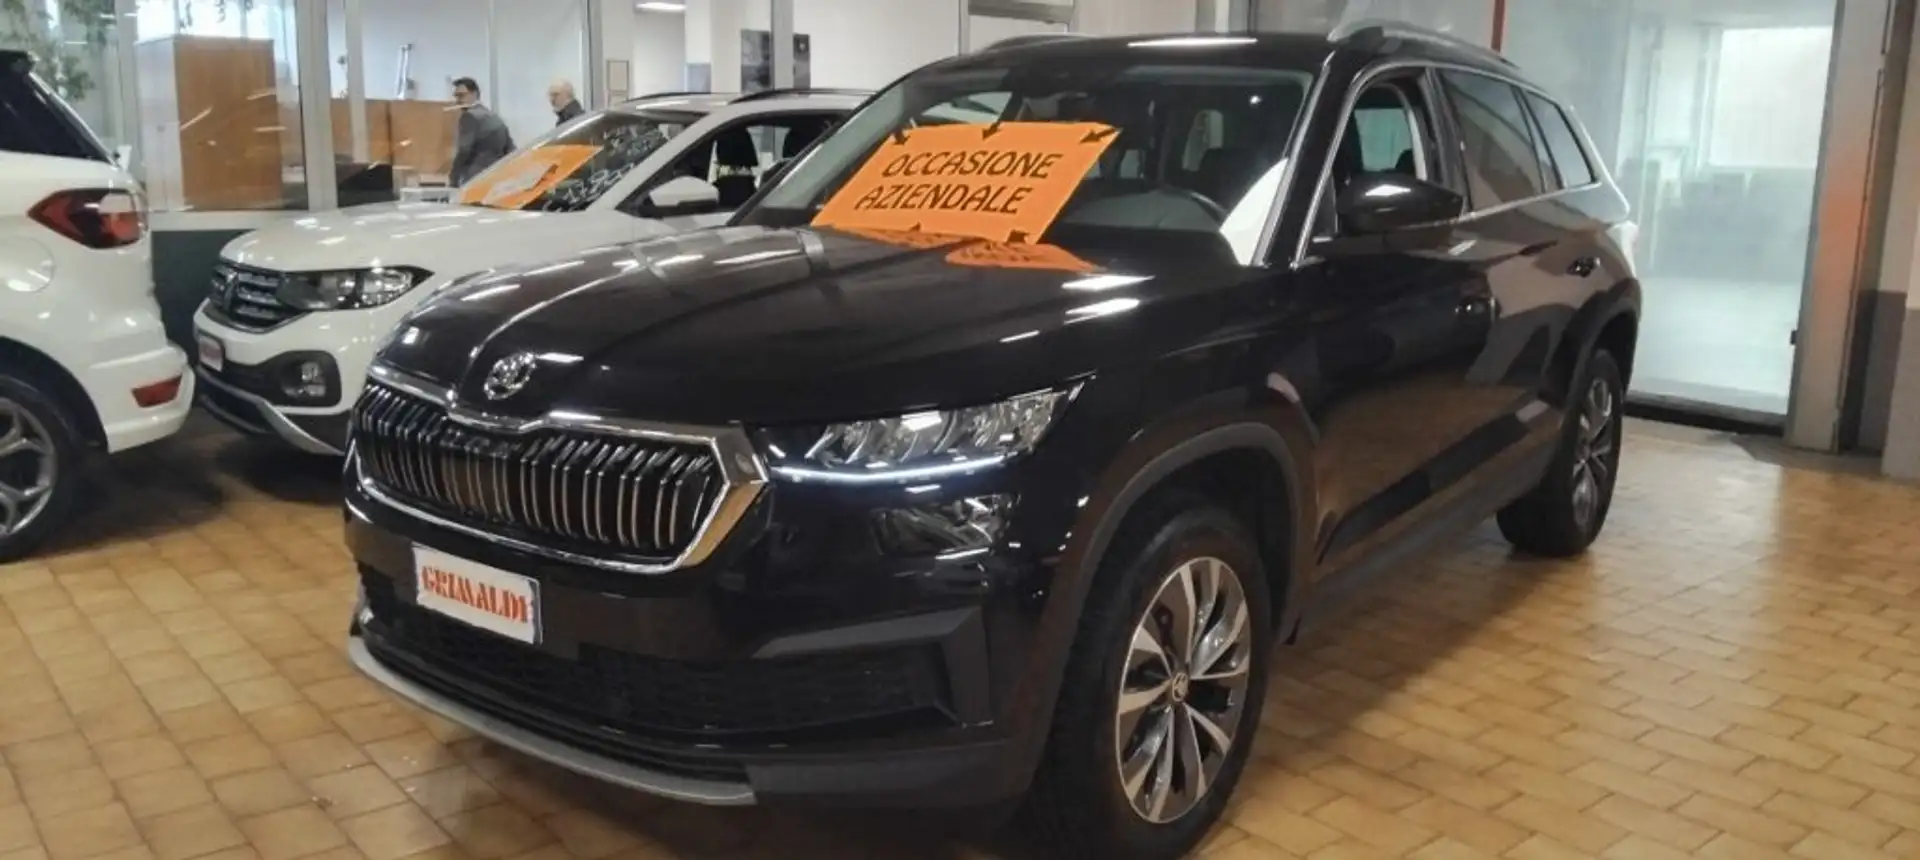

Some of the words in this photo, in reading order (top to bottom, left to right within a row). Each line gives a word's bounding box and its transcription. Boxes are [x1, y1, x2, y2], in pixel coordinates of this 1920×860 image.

[882, 150, 1062, 178] OCCASIONE
[854, 183, 1034, 213] AZIENDALE
[422, 565, 528, 623] GRIMALDI
